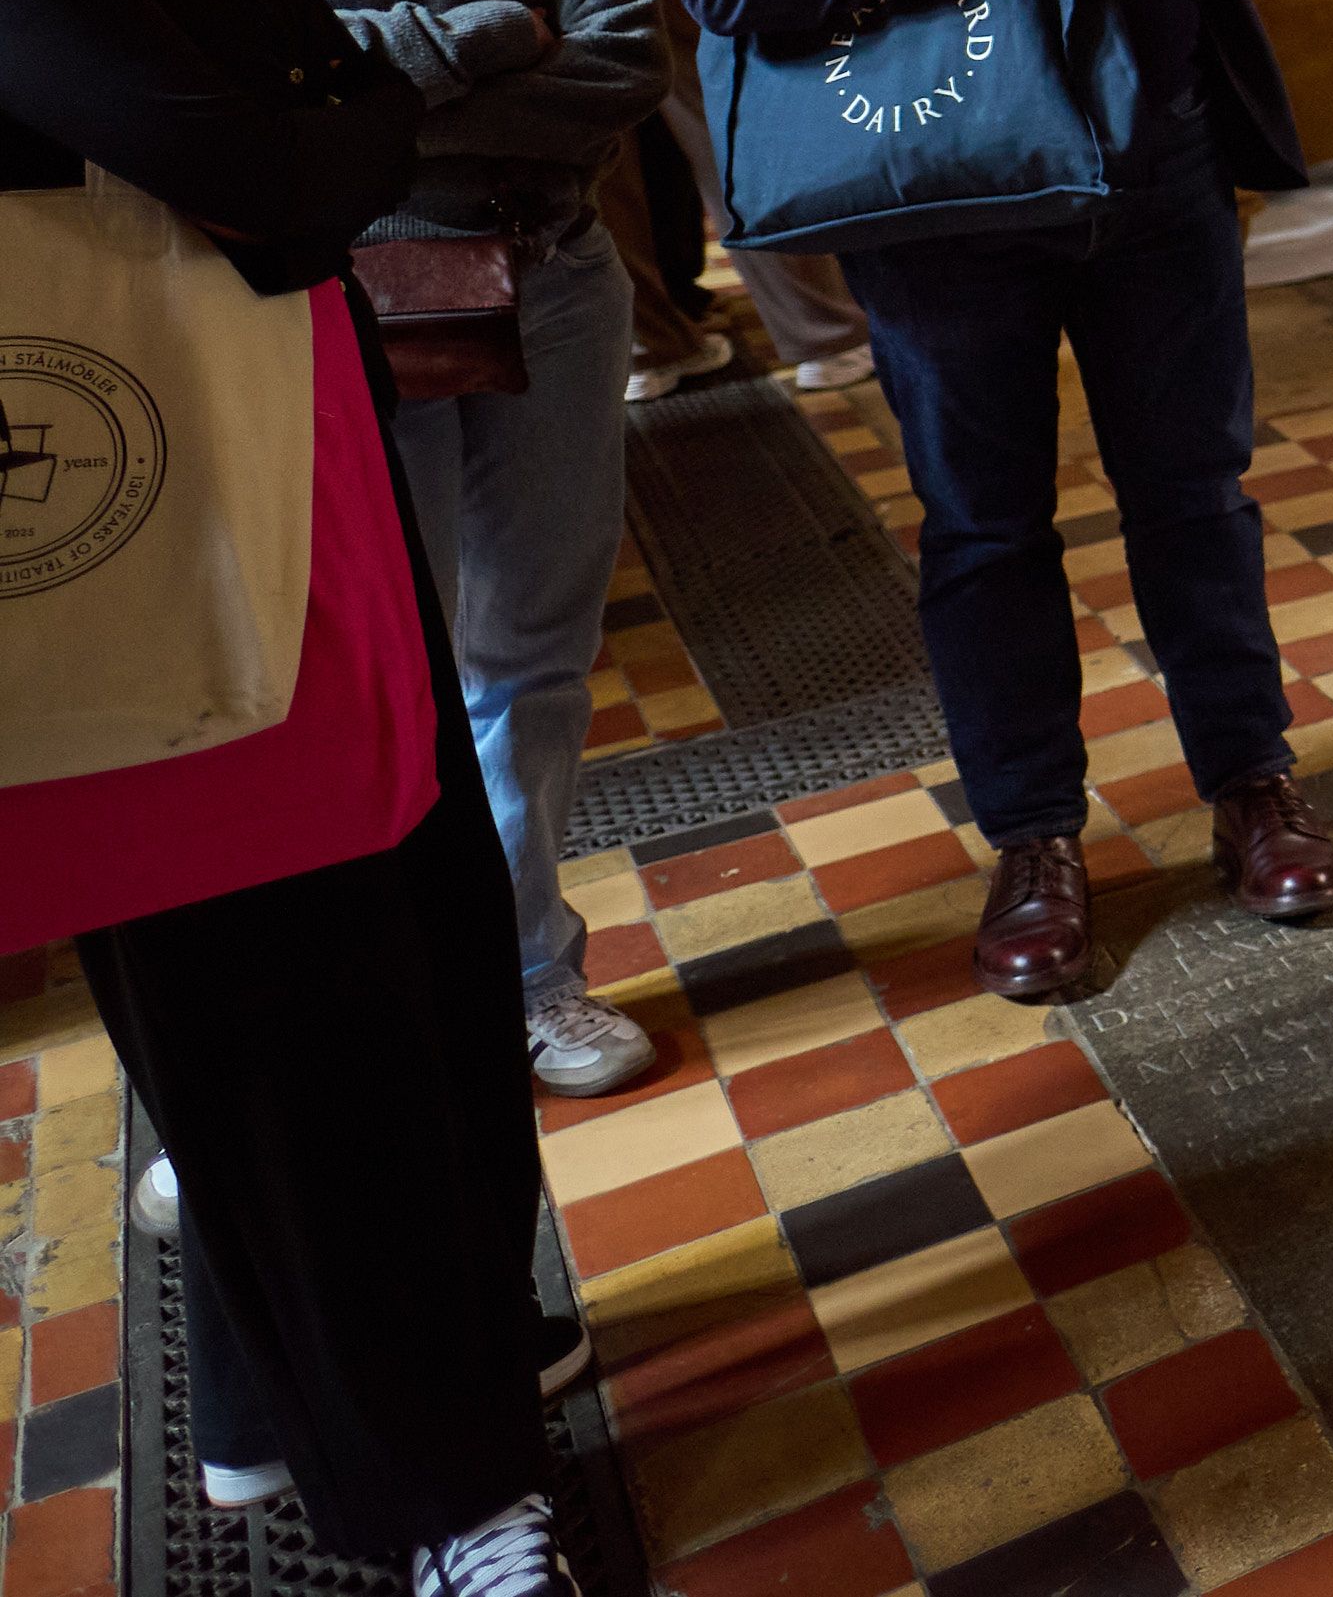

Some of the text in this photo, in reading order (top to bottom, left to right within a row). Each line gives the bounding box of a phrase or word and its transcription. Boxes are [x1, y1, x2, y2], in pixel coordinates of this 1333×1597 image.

[841, 76, 965, 134] DAIRY
[64, 457, 109, 473] years
[125, 475, 147, 499] 130
[93, 503, 134, 543] YEARS
[70, 542, 92, 562] OF
